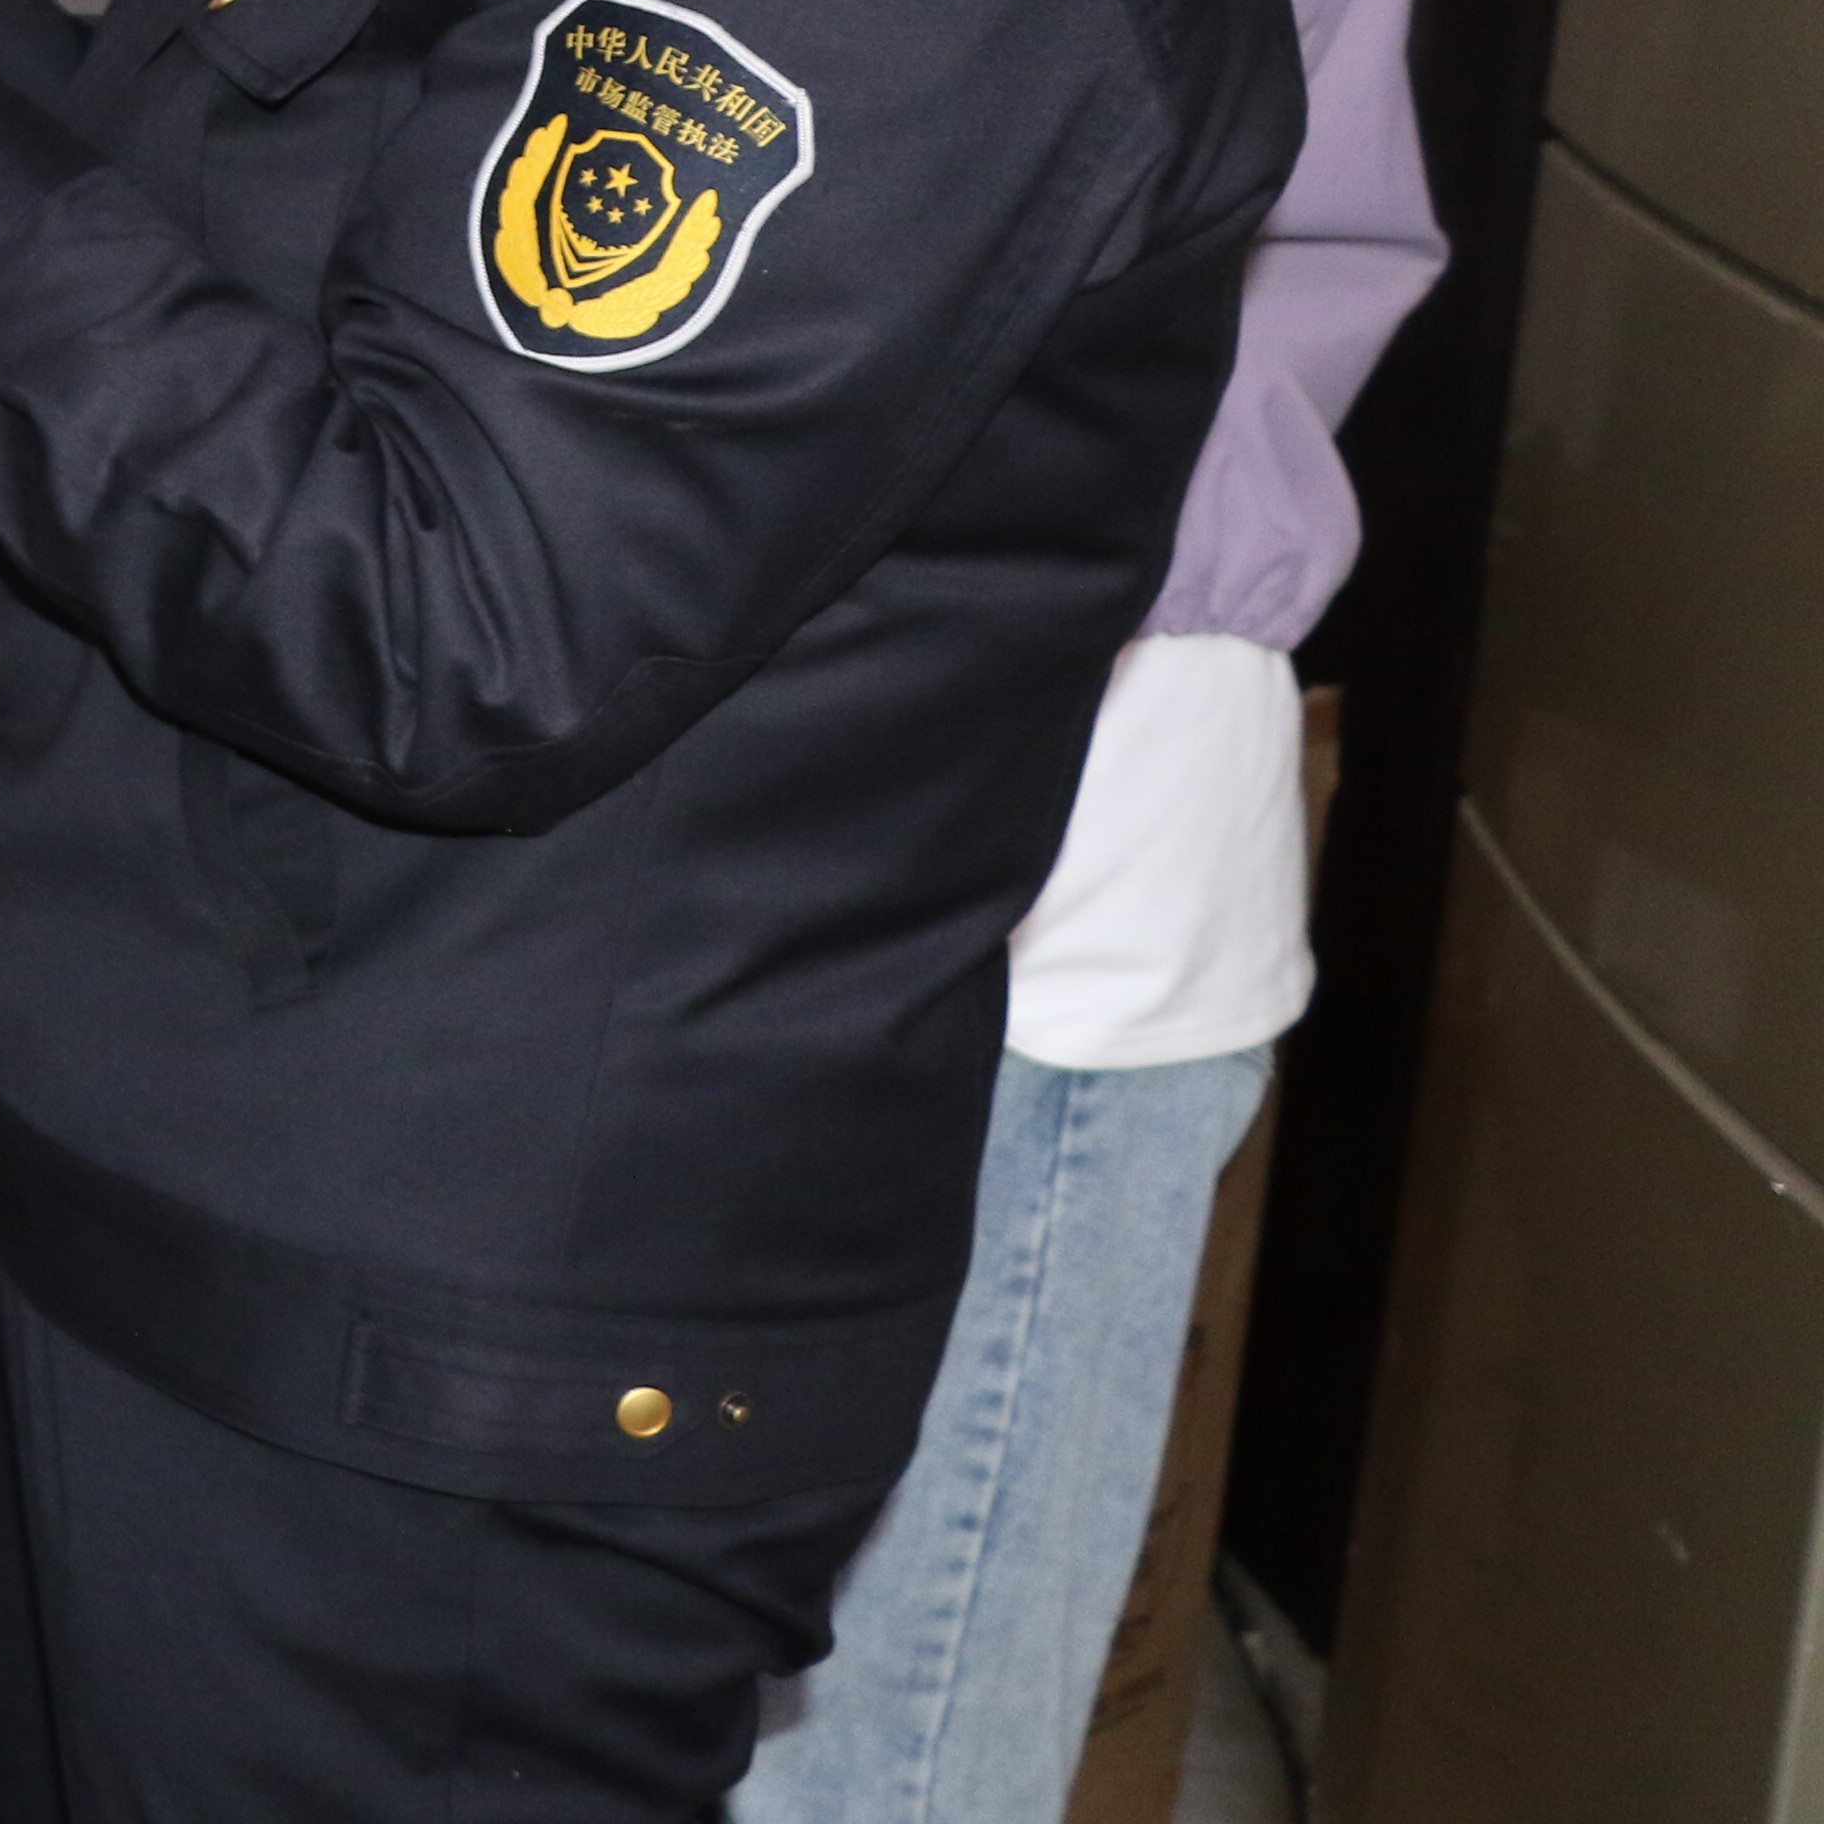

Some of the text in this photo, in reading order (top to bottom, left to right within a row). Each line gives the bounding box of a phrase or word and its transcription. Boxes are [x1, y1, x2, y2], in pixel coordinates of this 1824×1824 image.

[565, 24, 787, 148] 中华人民共和国
[574, 66, 741, 165] 市场监管执法
